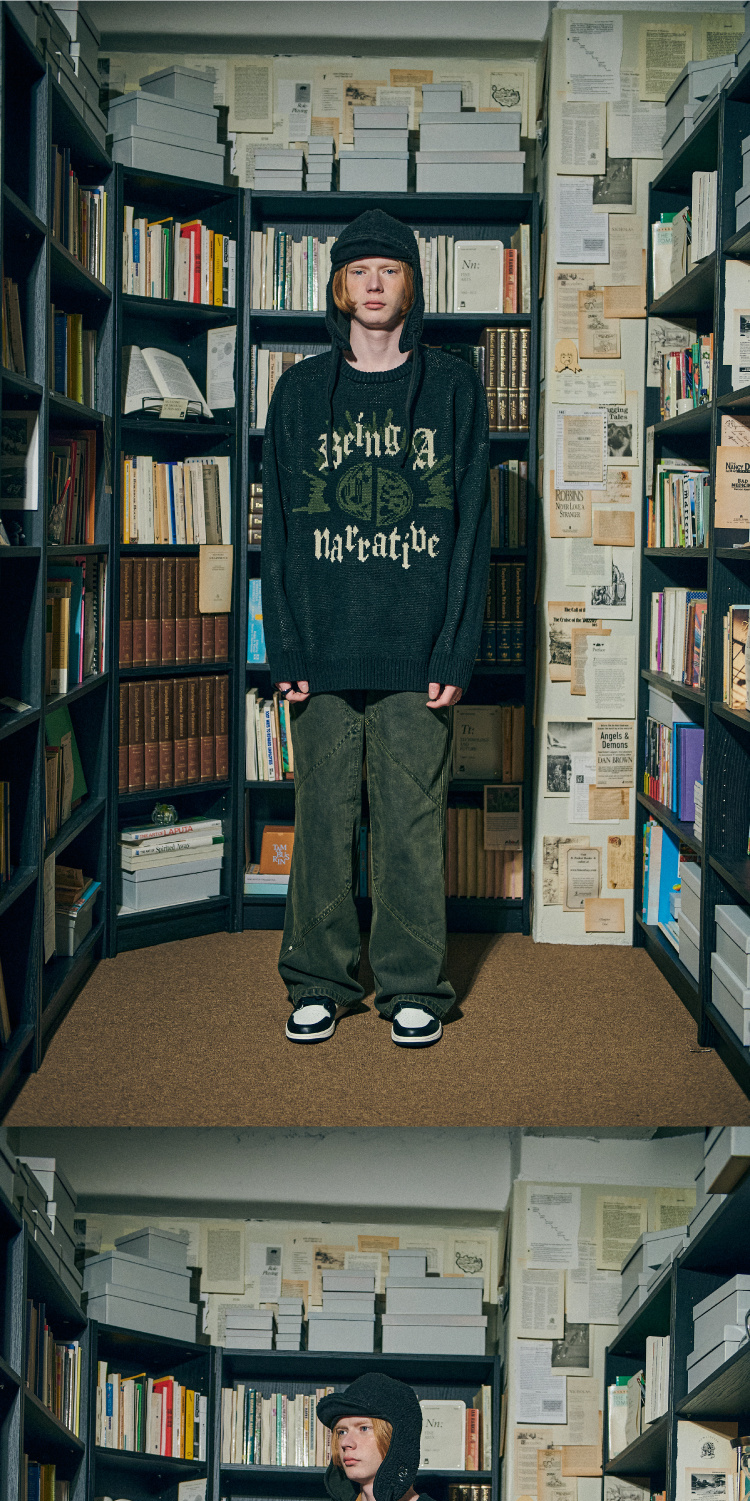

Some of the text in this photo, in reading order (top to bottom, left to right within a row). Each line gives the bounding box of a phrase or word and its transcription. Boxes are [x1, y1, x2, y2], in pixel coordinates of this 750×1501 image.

[412, 427, 438, 470] A
[314, 521, 440, 569] narrative
[600, 731, 629, 742] Angels &
[602, 740, 628, 749] Demons
[164, 826, 193, 837] LAPUTA
